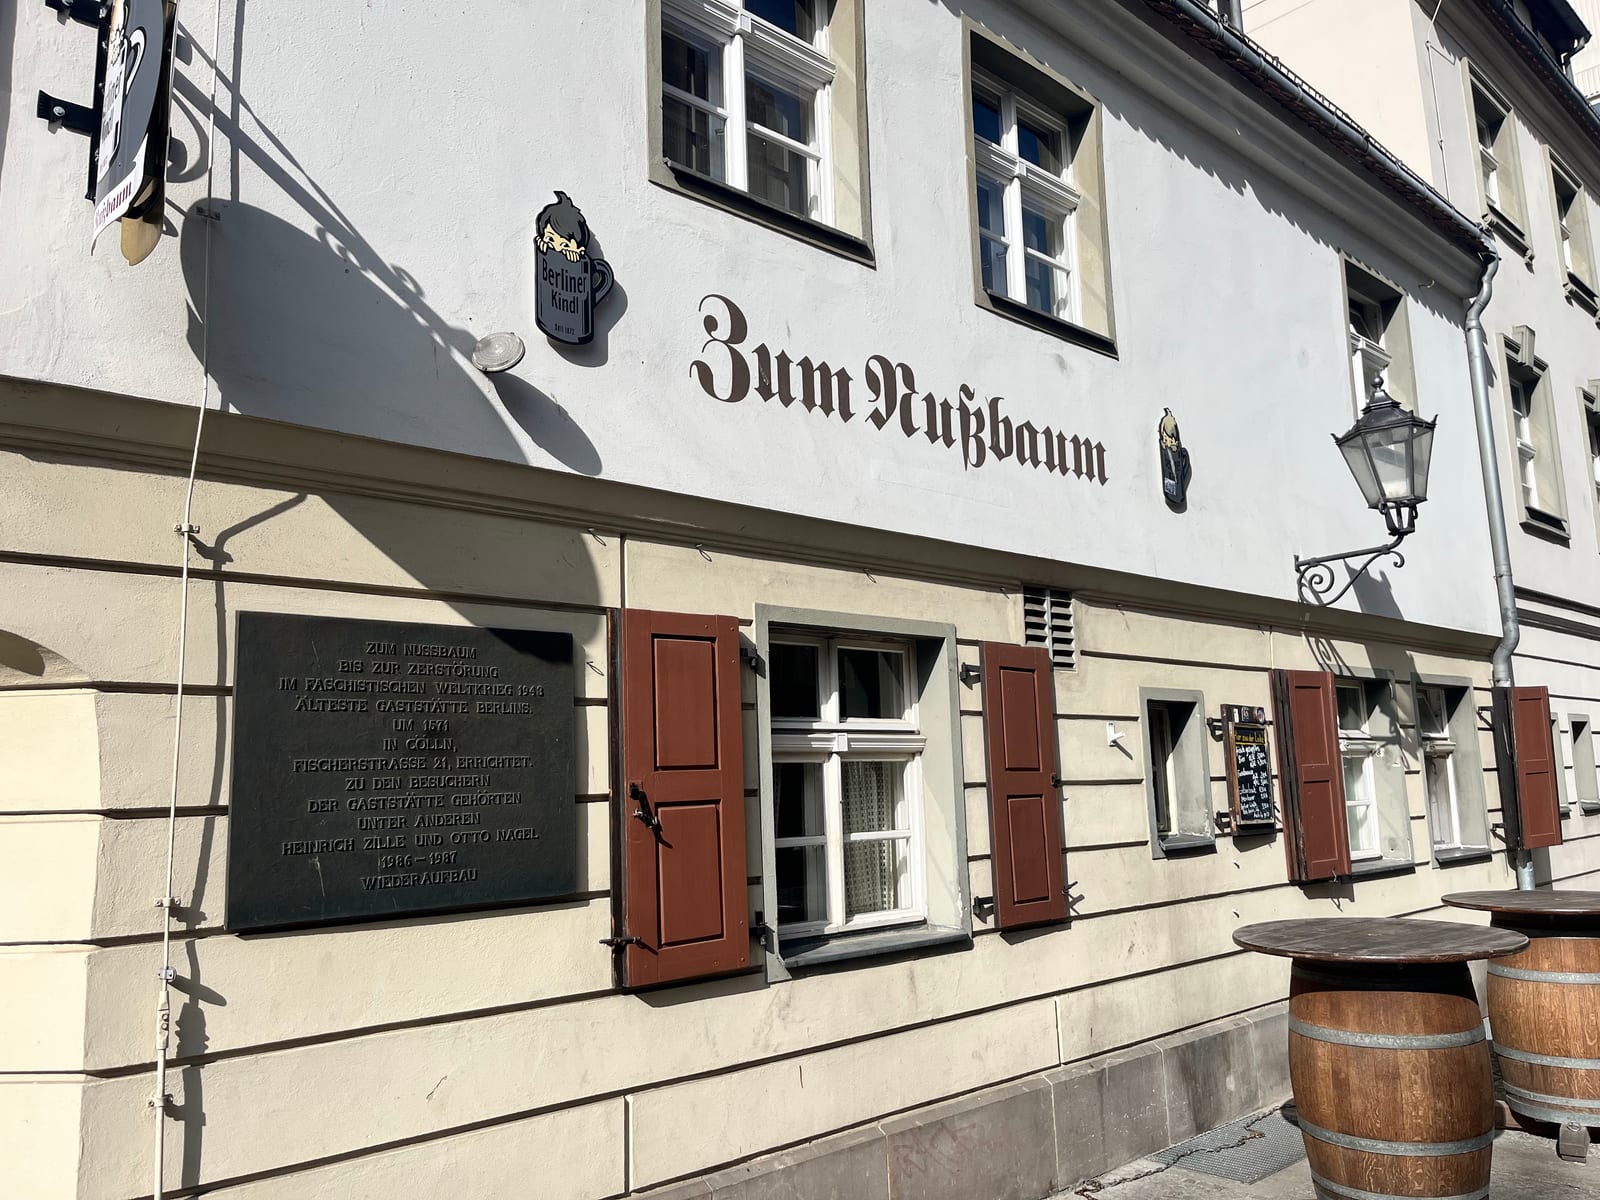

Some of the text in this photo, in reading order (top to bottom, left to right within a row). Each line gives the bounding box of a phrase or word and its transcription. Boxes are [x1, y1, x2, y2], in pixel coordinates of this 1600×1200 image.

[542, 258, 587, 294] Berliner
[551, 289, 579, 314] Kindl
[689, 294, 1109, 487] Zum Nußbaum
[366, 642, 477, 659] ZUM NUSSBAUM
[338, 660, 499, 678] BIS ZUR ZERSTÖRUNG
[278, 677, 298, 691] IM
[304, 677, 426, 694] FASCHISTISCHEN
[435, 681, 514, 697] WELTKRIEG
[295, 695, 369, 712] ÄLTESTE
[376, 697, 470, 714] GASTSTÄTTE
[393, 719, 450, 732] UM 1571
[383, 738, 399, 751] IN
[292, 757, 428, 773] FISCHERSTRASSE
[345, 775, 491, 791] ZU DEN BESUCHERN
[307, 789, 522, 813] DER GASTSTÄTTE GEHÖRTEN
[357, 812, 481, 830] UNTER ANDEREN
[281, 827, 541, 856] HEINRICH ZILLE UND OTTO NAGEL
[360, 868, 479, 890] WIEDERAUFBAU
